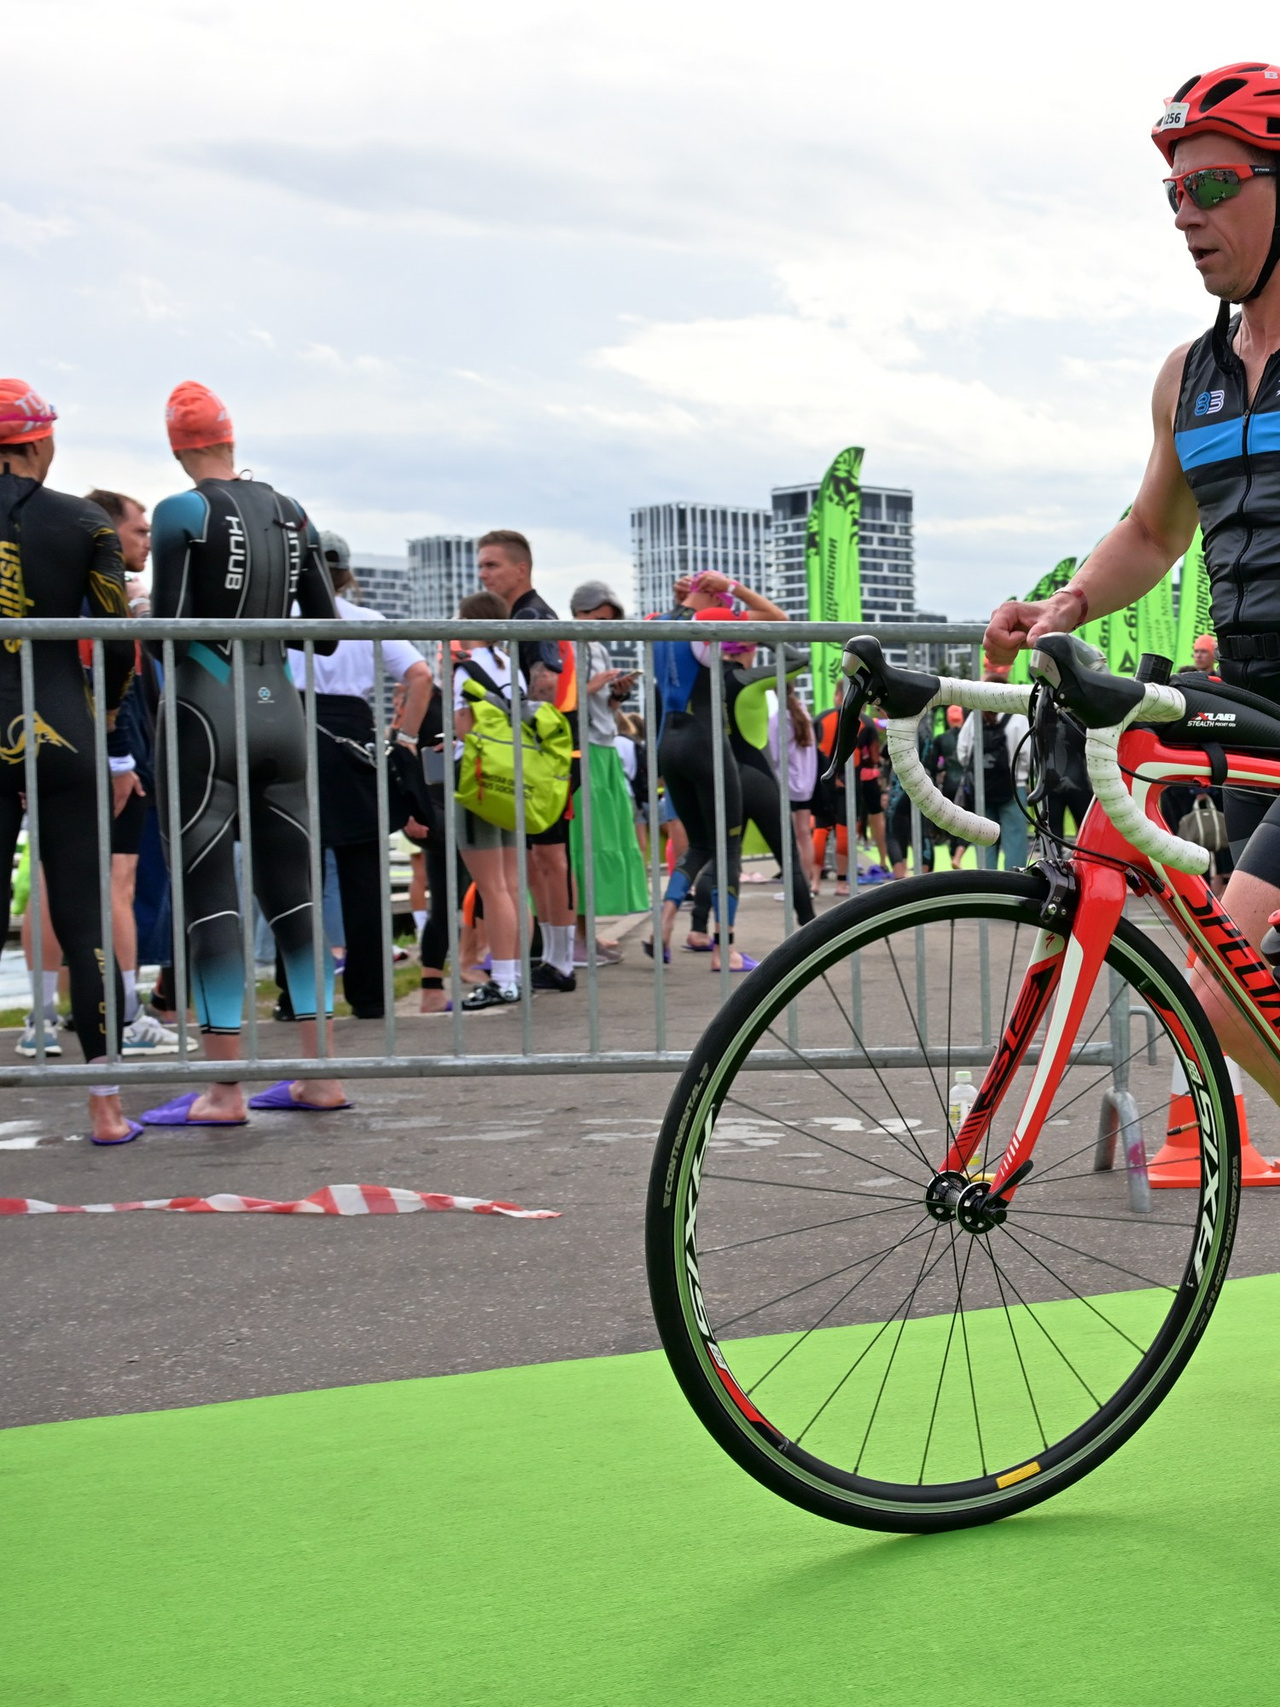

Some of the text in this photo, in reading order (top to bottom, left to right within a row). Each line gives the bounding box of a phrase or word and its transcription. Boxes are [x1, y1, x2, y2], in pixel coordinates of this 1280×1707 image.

[225, 516, 246, 590] HUUB
[0, 541, 35, 653] silfish
[664, 1081, 704, 1194] CONTINENTAL
[1230, 1166, 1239, 1216] GRAND
[1224, 1215, 1235, 1248] PRIX
